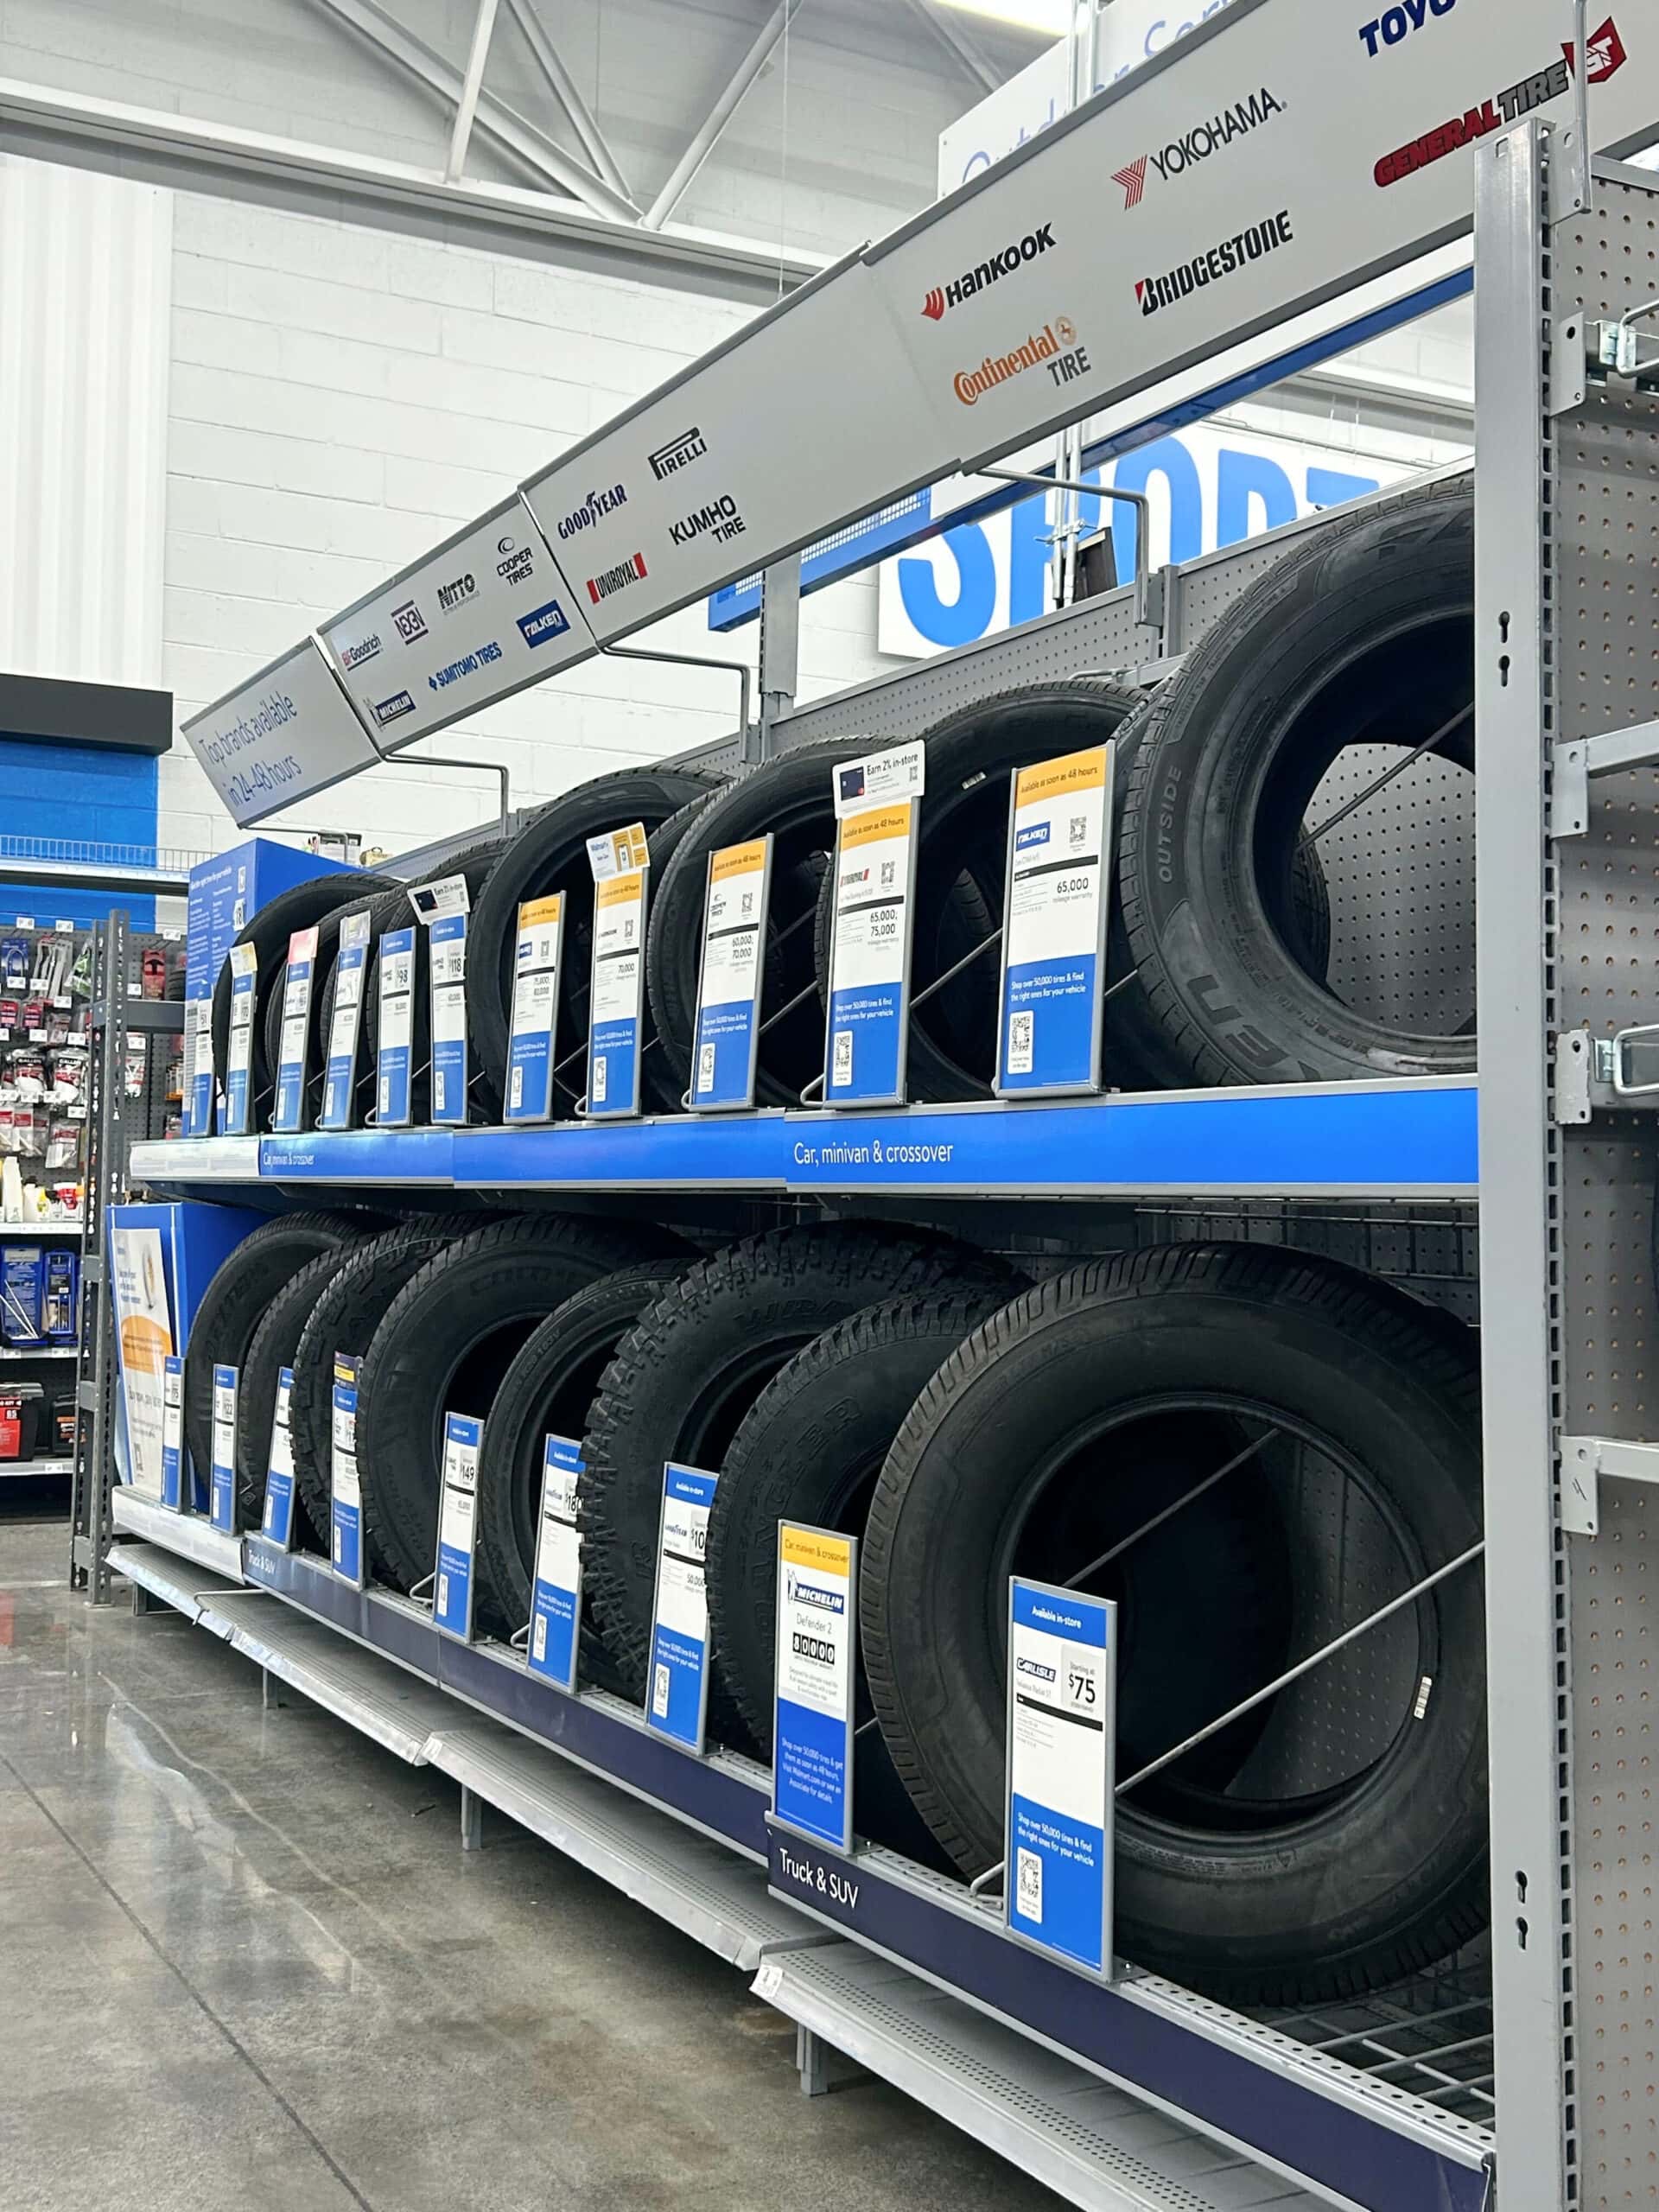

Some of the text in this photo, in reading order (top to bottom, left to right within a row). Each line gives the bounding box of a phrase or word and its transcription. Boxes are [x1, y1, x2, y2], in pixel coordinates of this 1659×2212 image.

[1150, 88, 1282, 180] YOKOHAMA
[1374, 59, 1569, 188] GENERAL TIRE
[1135, 210, 1294, 316] BRIDGESTONE
[954, 323, 1060, 406] Continental
[1047, 346, 1091, 388] TIRE
[648, 427, 708, 480] PIRELLI
[557, 485, 627, 539] GOODYEAR
[669, 494, 736, 545] KUMHO
[711, 516, 747, 543] TIRE
[496, 547, 533, 576] COOPER
[506, 563, 533, 586] TIRES
[437, 574, 475, 609] NITTO
[595, 559, 639, 600] UNIROYAL
[524, 610, 562, 639] FALKEN
[436, 642, 502, 687] SUMITOMO TIRES
[199, 690, 296, 767] Top brands available
[867, 765, 881, 775] Earn
[893, 753, 918, 766] in-store
[1068, 769, 1077, 778] 48
[1078, 767, 1097, 777] hours
[223, 755, 302, 807] in 24-48 hours
[1157, 765, 1181, 884] OUTSIDE
[1057, 878, 1089, 893] 65,000
[870, 924, 895, 937] 75,000
[794, 1140, 953, 1167] Car, minivan & crossover
[797, 1586, 843, 1611] MICHELIN
[797, 1612, 832, 1634] Defender 2
[1032, 1605, 1081, 1629] Available in-store
[793, 1635, 835, 1663] 80000
[1017, 1658, 1056, 1682] CARLISLE
[1069, 1674, 1096, 1703] $75
[1060, 1847, 1072, 1857] your
[1073, 1852, 1094, 1866] vehicle
[1080, 1840, 1092, 1853] find
[779, 1847, 859, 1908] Truck & SUV
